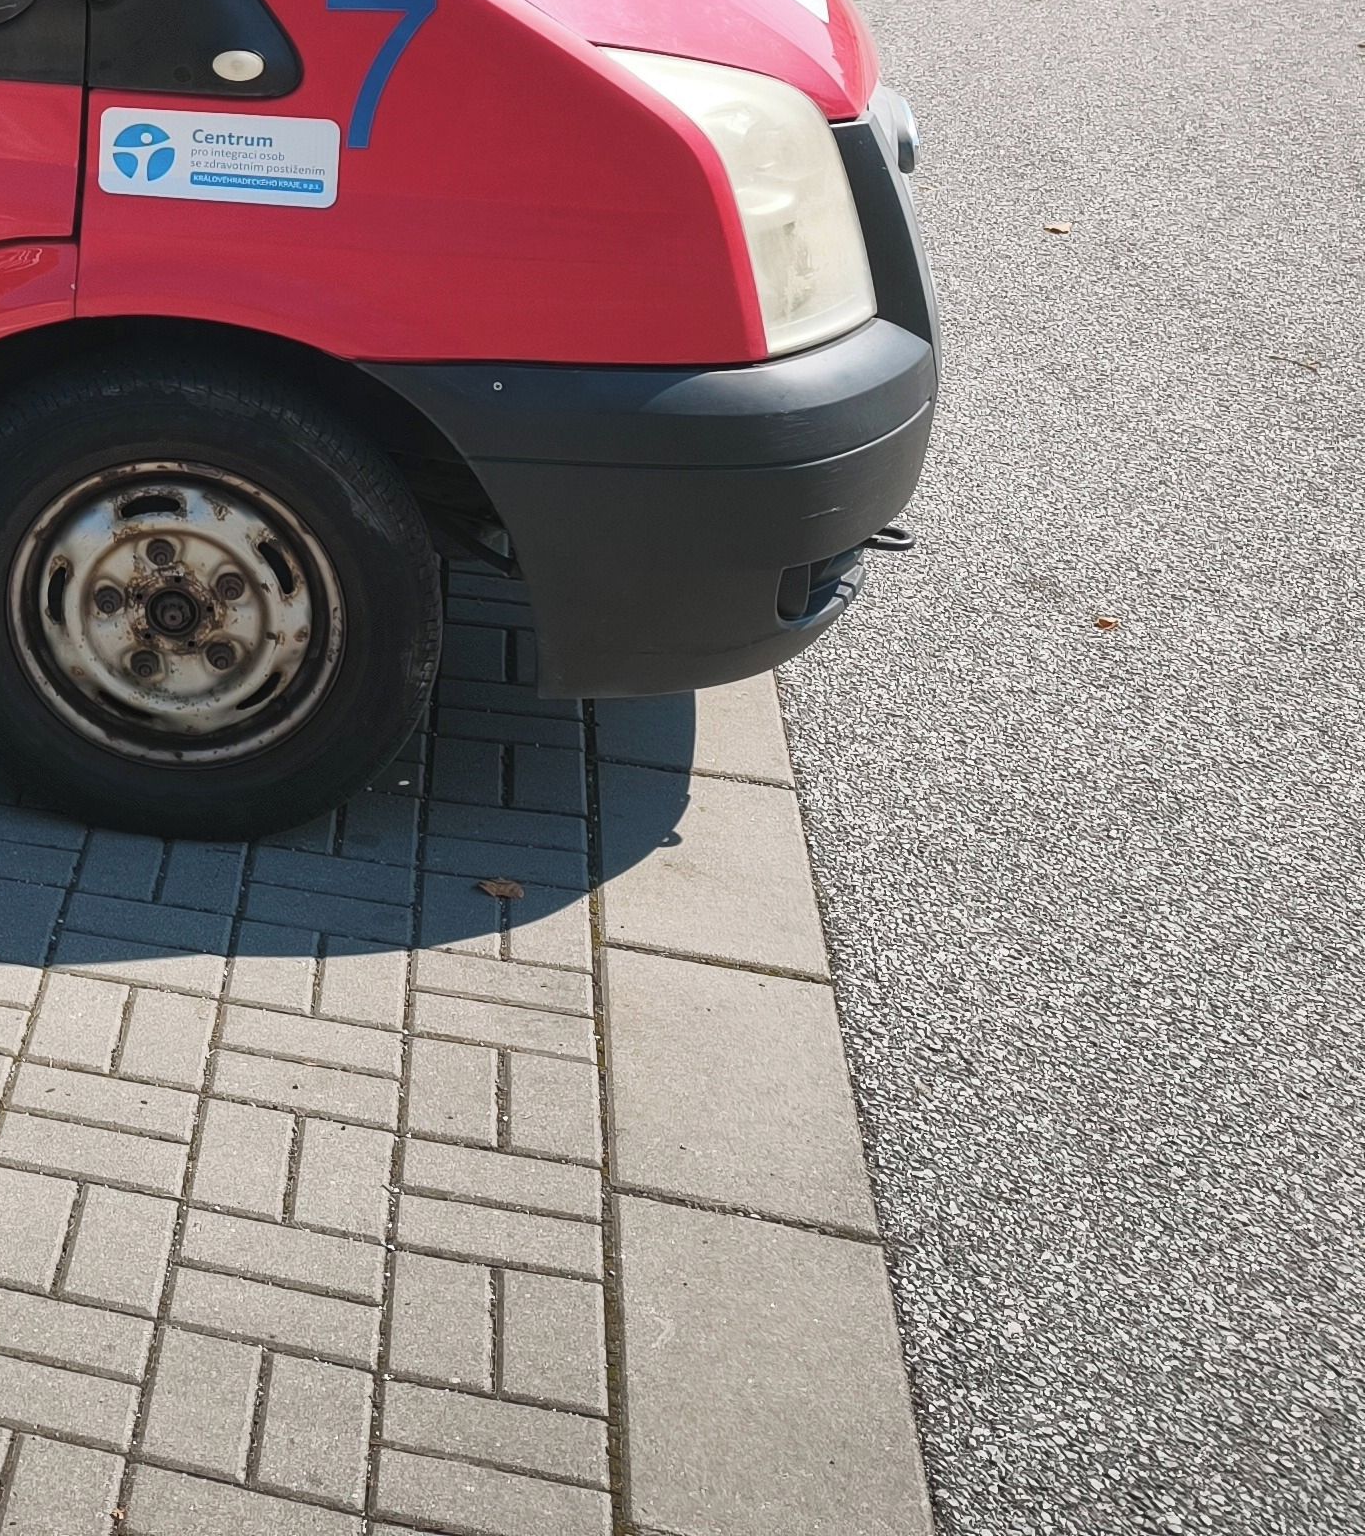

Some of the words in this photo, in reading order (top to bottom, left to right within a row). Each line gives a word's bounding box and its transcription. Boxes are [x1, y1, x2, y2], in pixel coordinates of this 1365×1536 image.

[192, 129, 273, 148] Centrum
[191, 148, 209, 157] pro
[211, 148, 257, 160] integraci
[259, 152, 285, 161] osob
